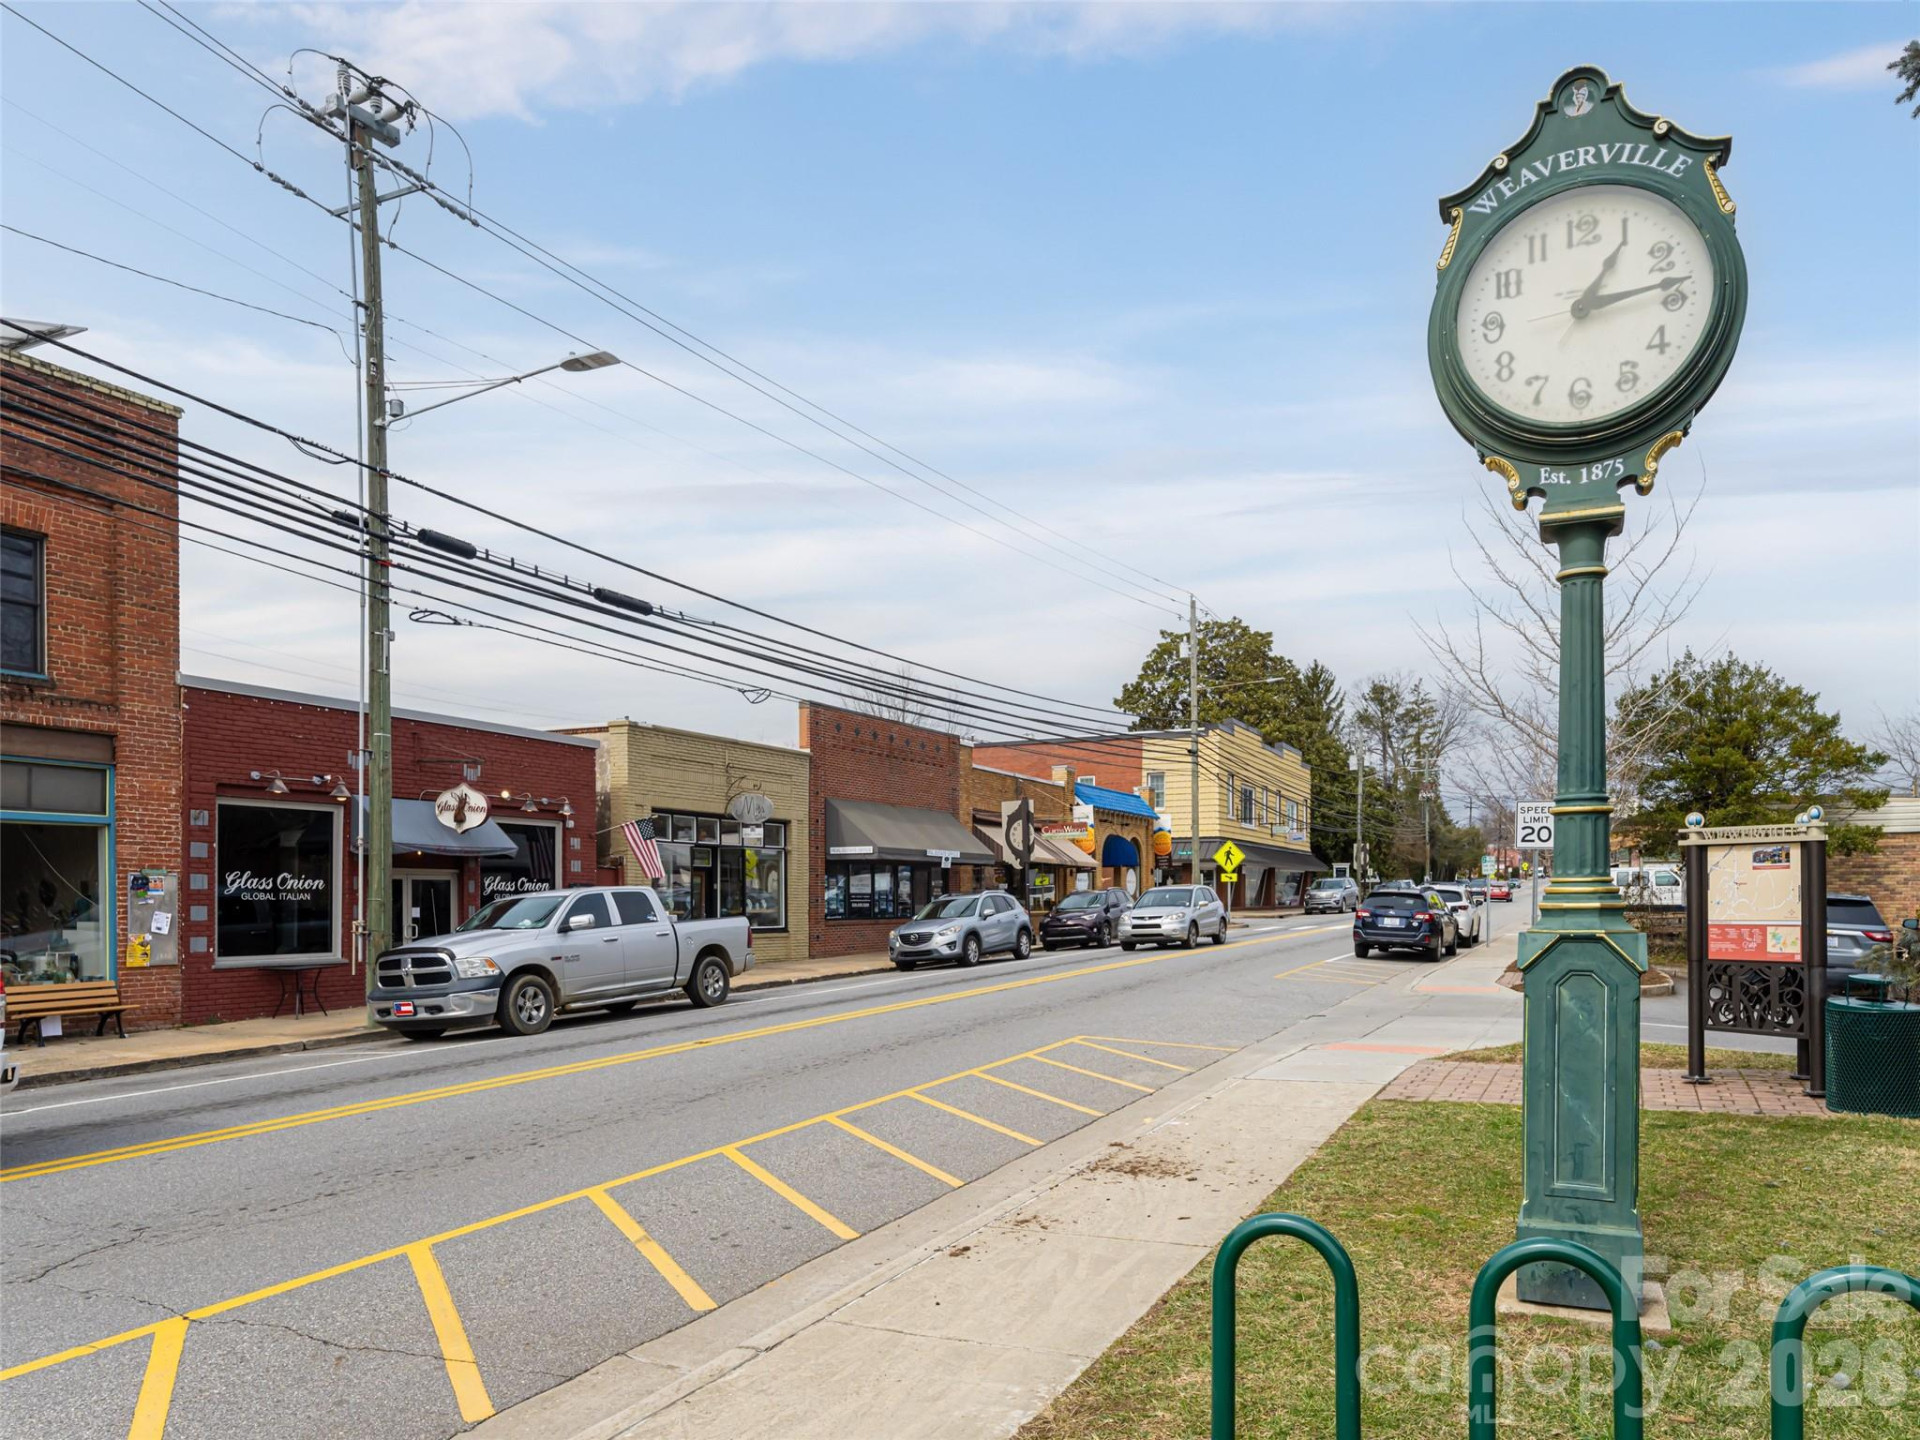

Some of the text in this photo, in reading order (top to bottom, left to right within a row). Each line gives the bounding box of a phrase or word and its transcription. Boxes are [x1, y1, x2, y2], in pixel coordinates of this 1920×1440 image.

[1468, 142, 1693, 214] WEAVERVILLE
[1566, 214, 1602, 249] 12
[1621, 217, 1629, 247] 1
[1525, 233, 1547, 264] 11
[1647, 241, 1675, 275] 2
[1495, 268, 1523, 300] 10
[1660, 278, 1688, 312] 3
[1481, 311, 1506, 344] 9
[1646, 324, 1671, 355] 4
[1494, 351, 1515, 382] 8
[1615, 360, 1639, 392] 5
[1525, 375, 1549, 406] 7
[1568, 377, 1593, 409] 6
[1539, 458, 1624, 485] Est. 1875
[1520, 826, 1552, 843] 20
[1523, 816, 1550, 824] LIMIT
[224, 870, 325, 895] Glass Onion
[241, 892, 311, 900] GLOBAL ITALIAN
[483, 876, 550, 896] Glass Onion
